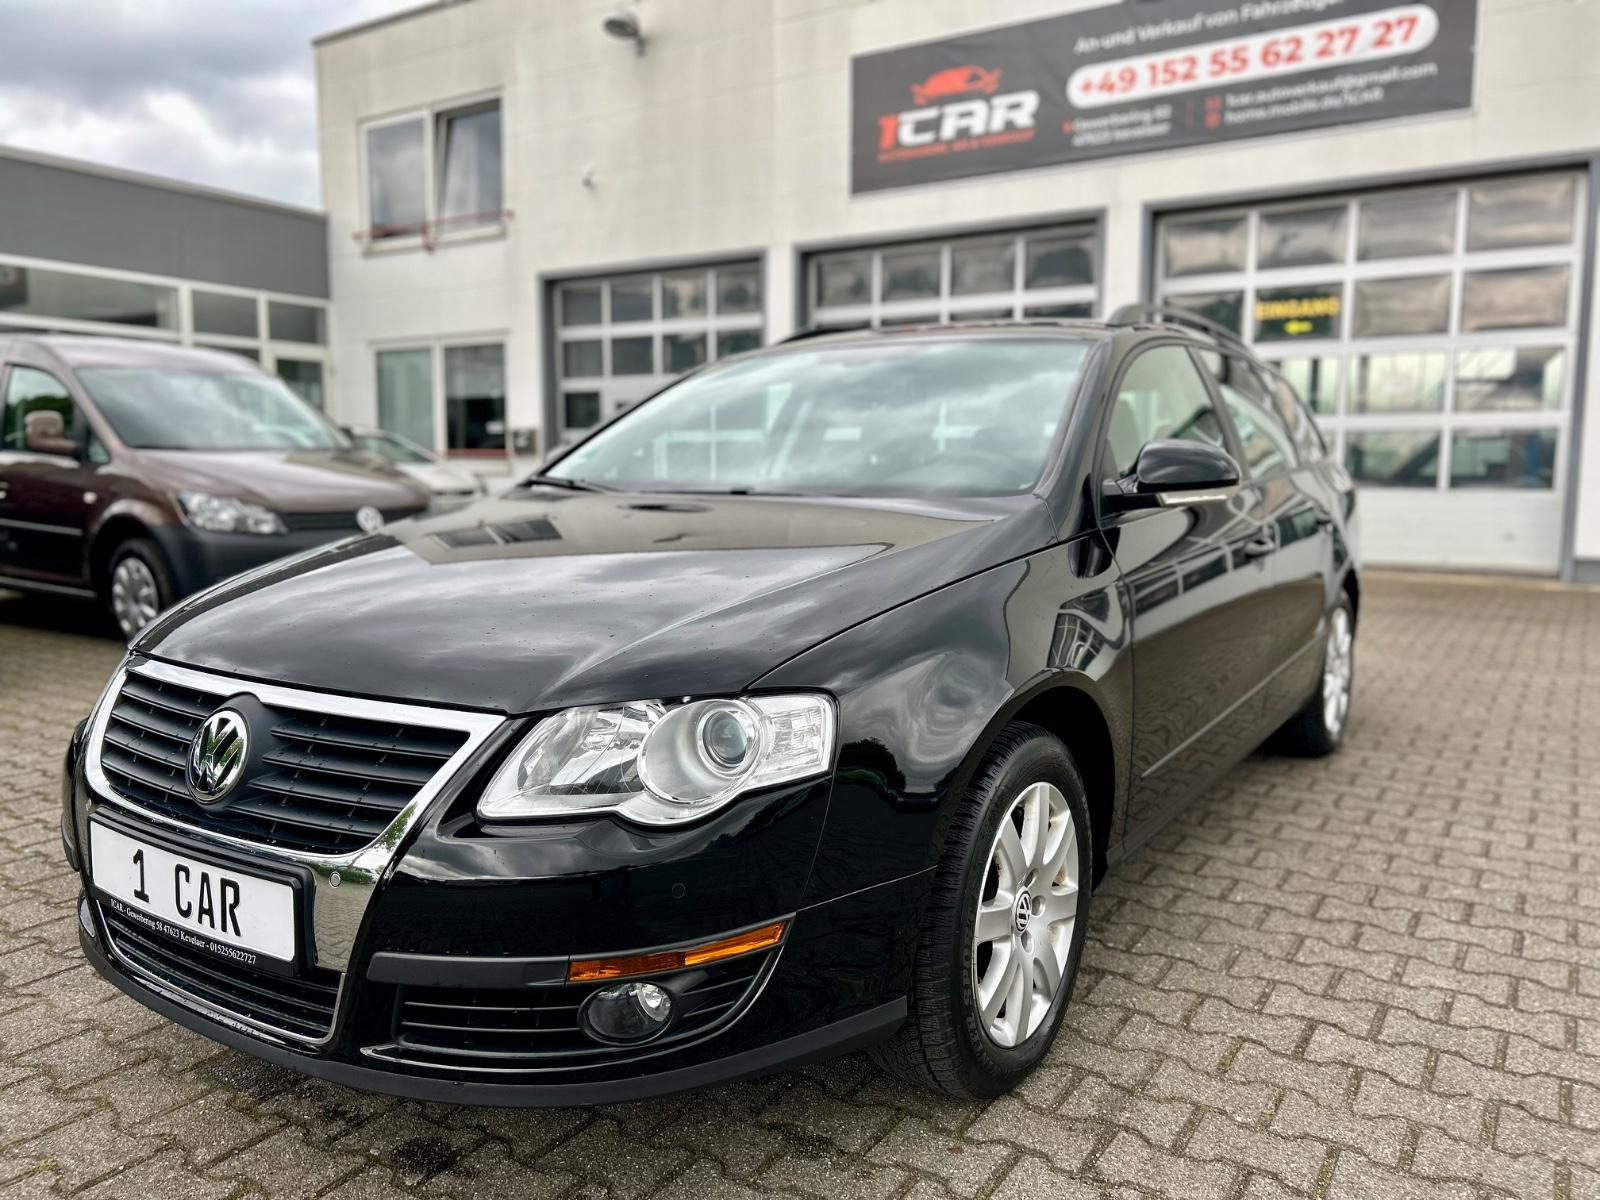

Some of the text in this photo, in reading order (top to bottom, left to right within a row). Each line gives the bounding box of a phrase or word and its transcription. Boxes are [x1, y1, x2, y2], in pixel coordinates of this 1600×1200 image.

[1081, 15, 1419, 94] +49 152 55 62 27 27
[127, 907, 155, 930] Gewerbering
[156, 920, 163, 931] 58
[163, 924, 179, 938] 47623
[181, 931, 205, 948] Kevelaer
[133, 848, 242, 937] 1 CAR
